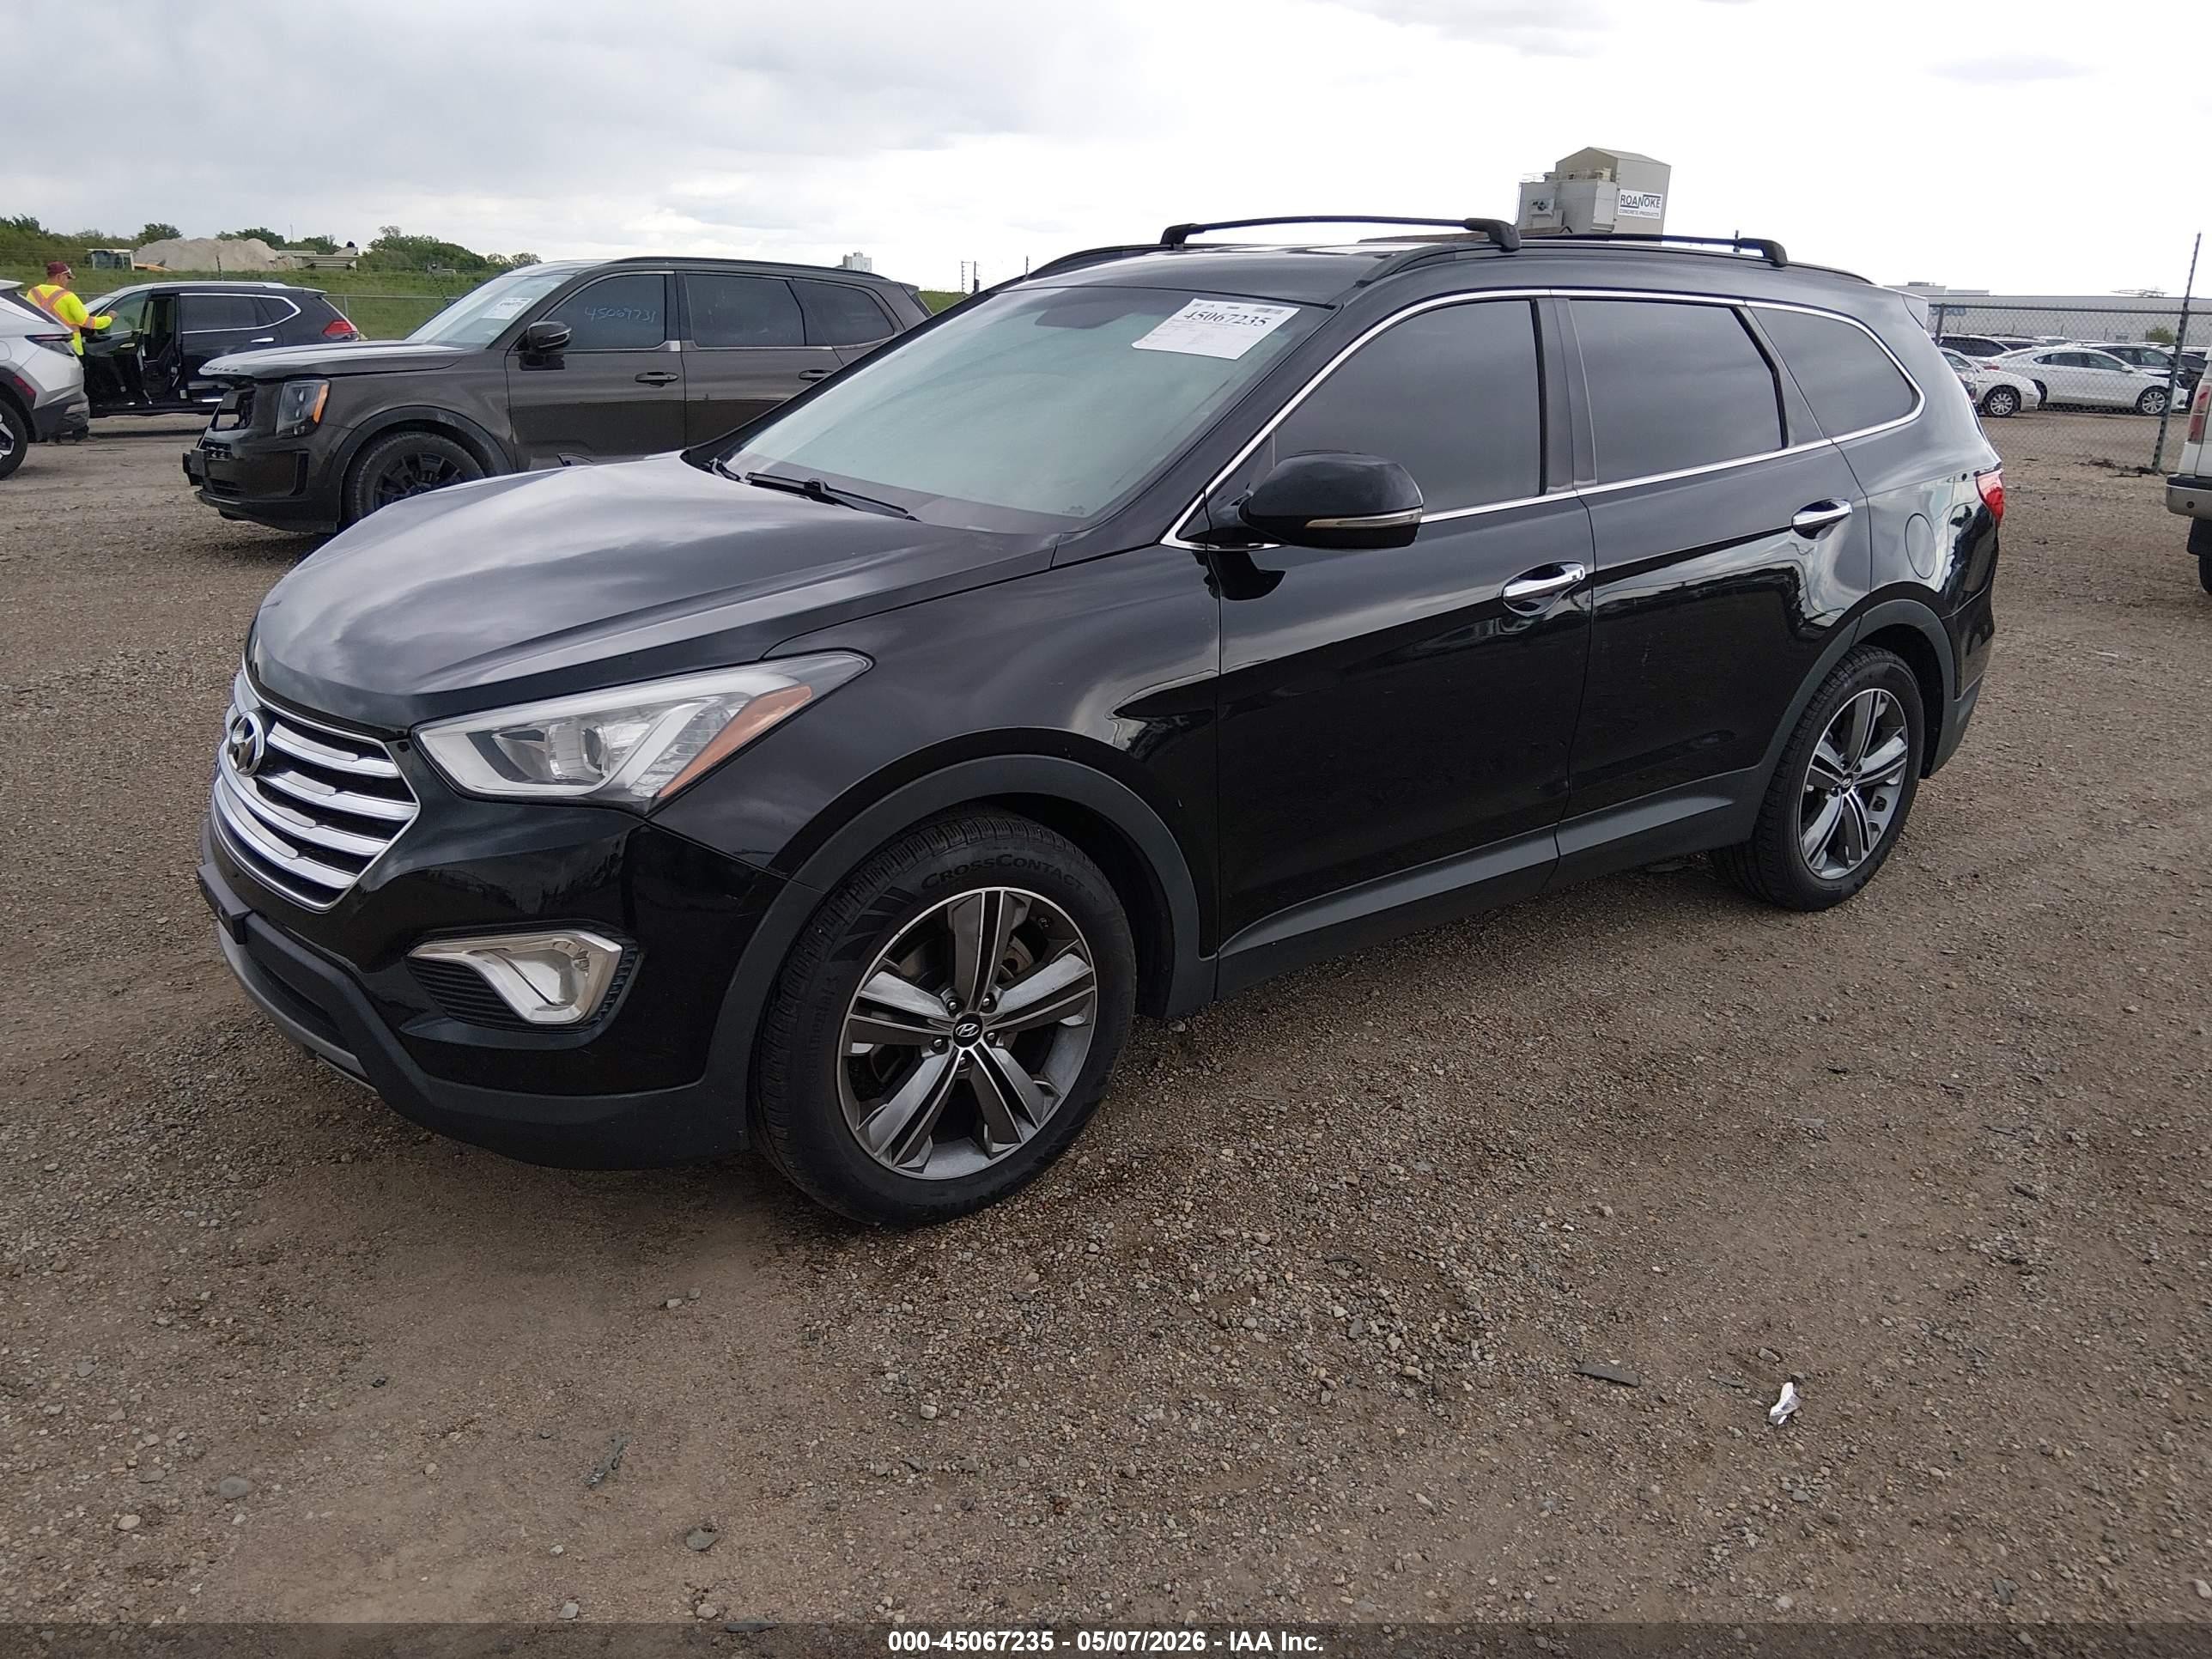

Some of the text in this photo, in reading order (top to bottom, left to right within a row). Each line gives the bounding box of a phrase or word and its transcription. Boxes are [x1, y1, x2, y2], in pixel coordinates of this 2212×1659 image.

[1620, 194, 1661, 209] ROANOKE
[584, 307, 656, 323] 45069731
[1183, 311, 1271, 327] 45067235
